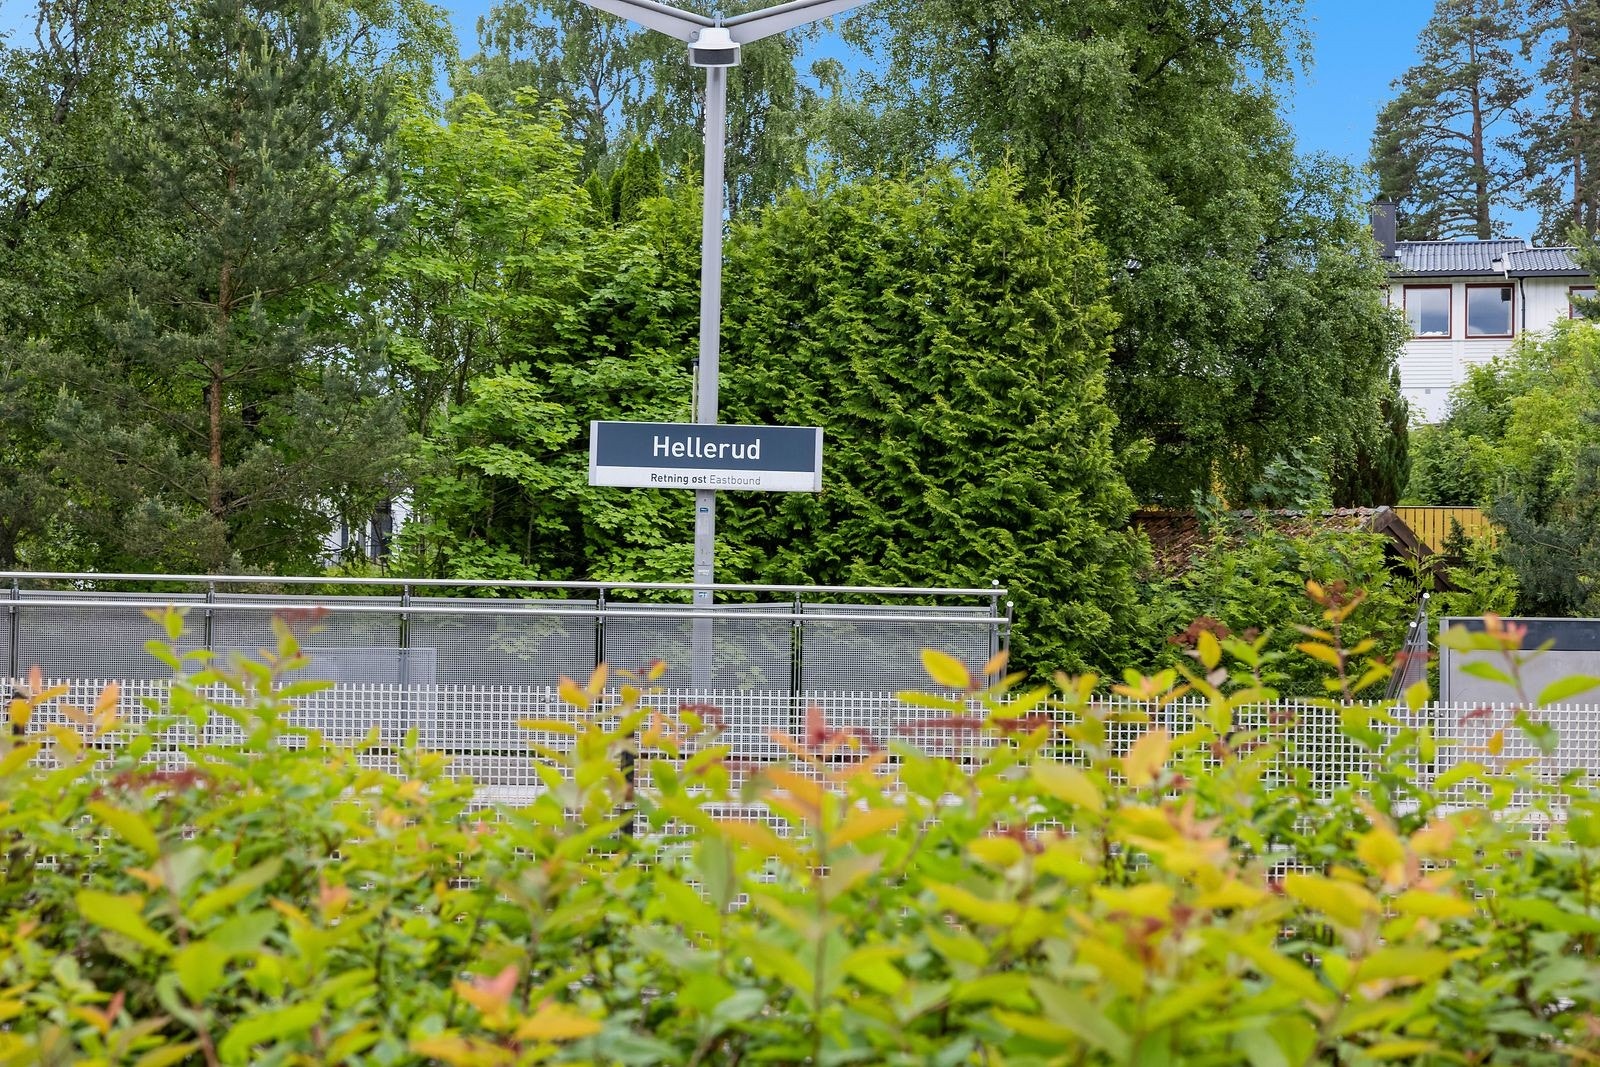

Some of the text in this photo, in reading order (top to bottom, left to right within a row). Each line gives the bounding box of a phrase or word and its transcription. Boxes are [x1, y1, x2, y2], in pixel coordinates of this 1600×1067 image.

[652, 435, 761, 460] Hellerud
[650, 473, 761, 486] Retning øst Eastbound
